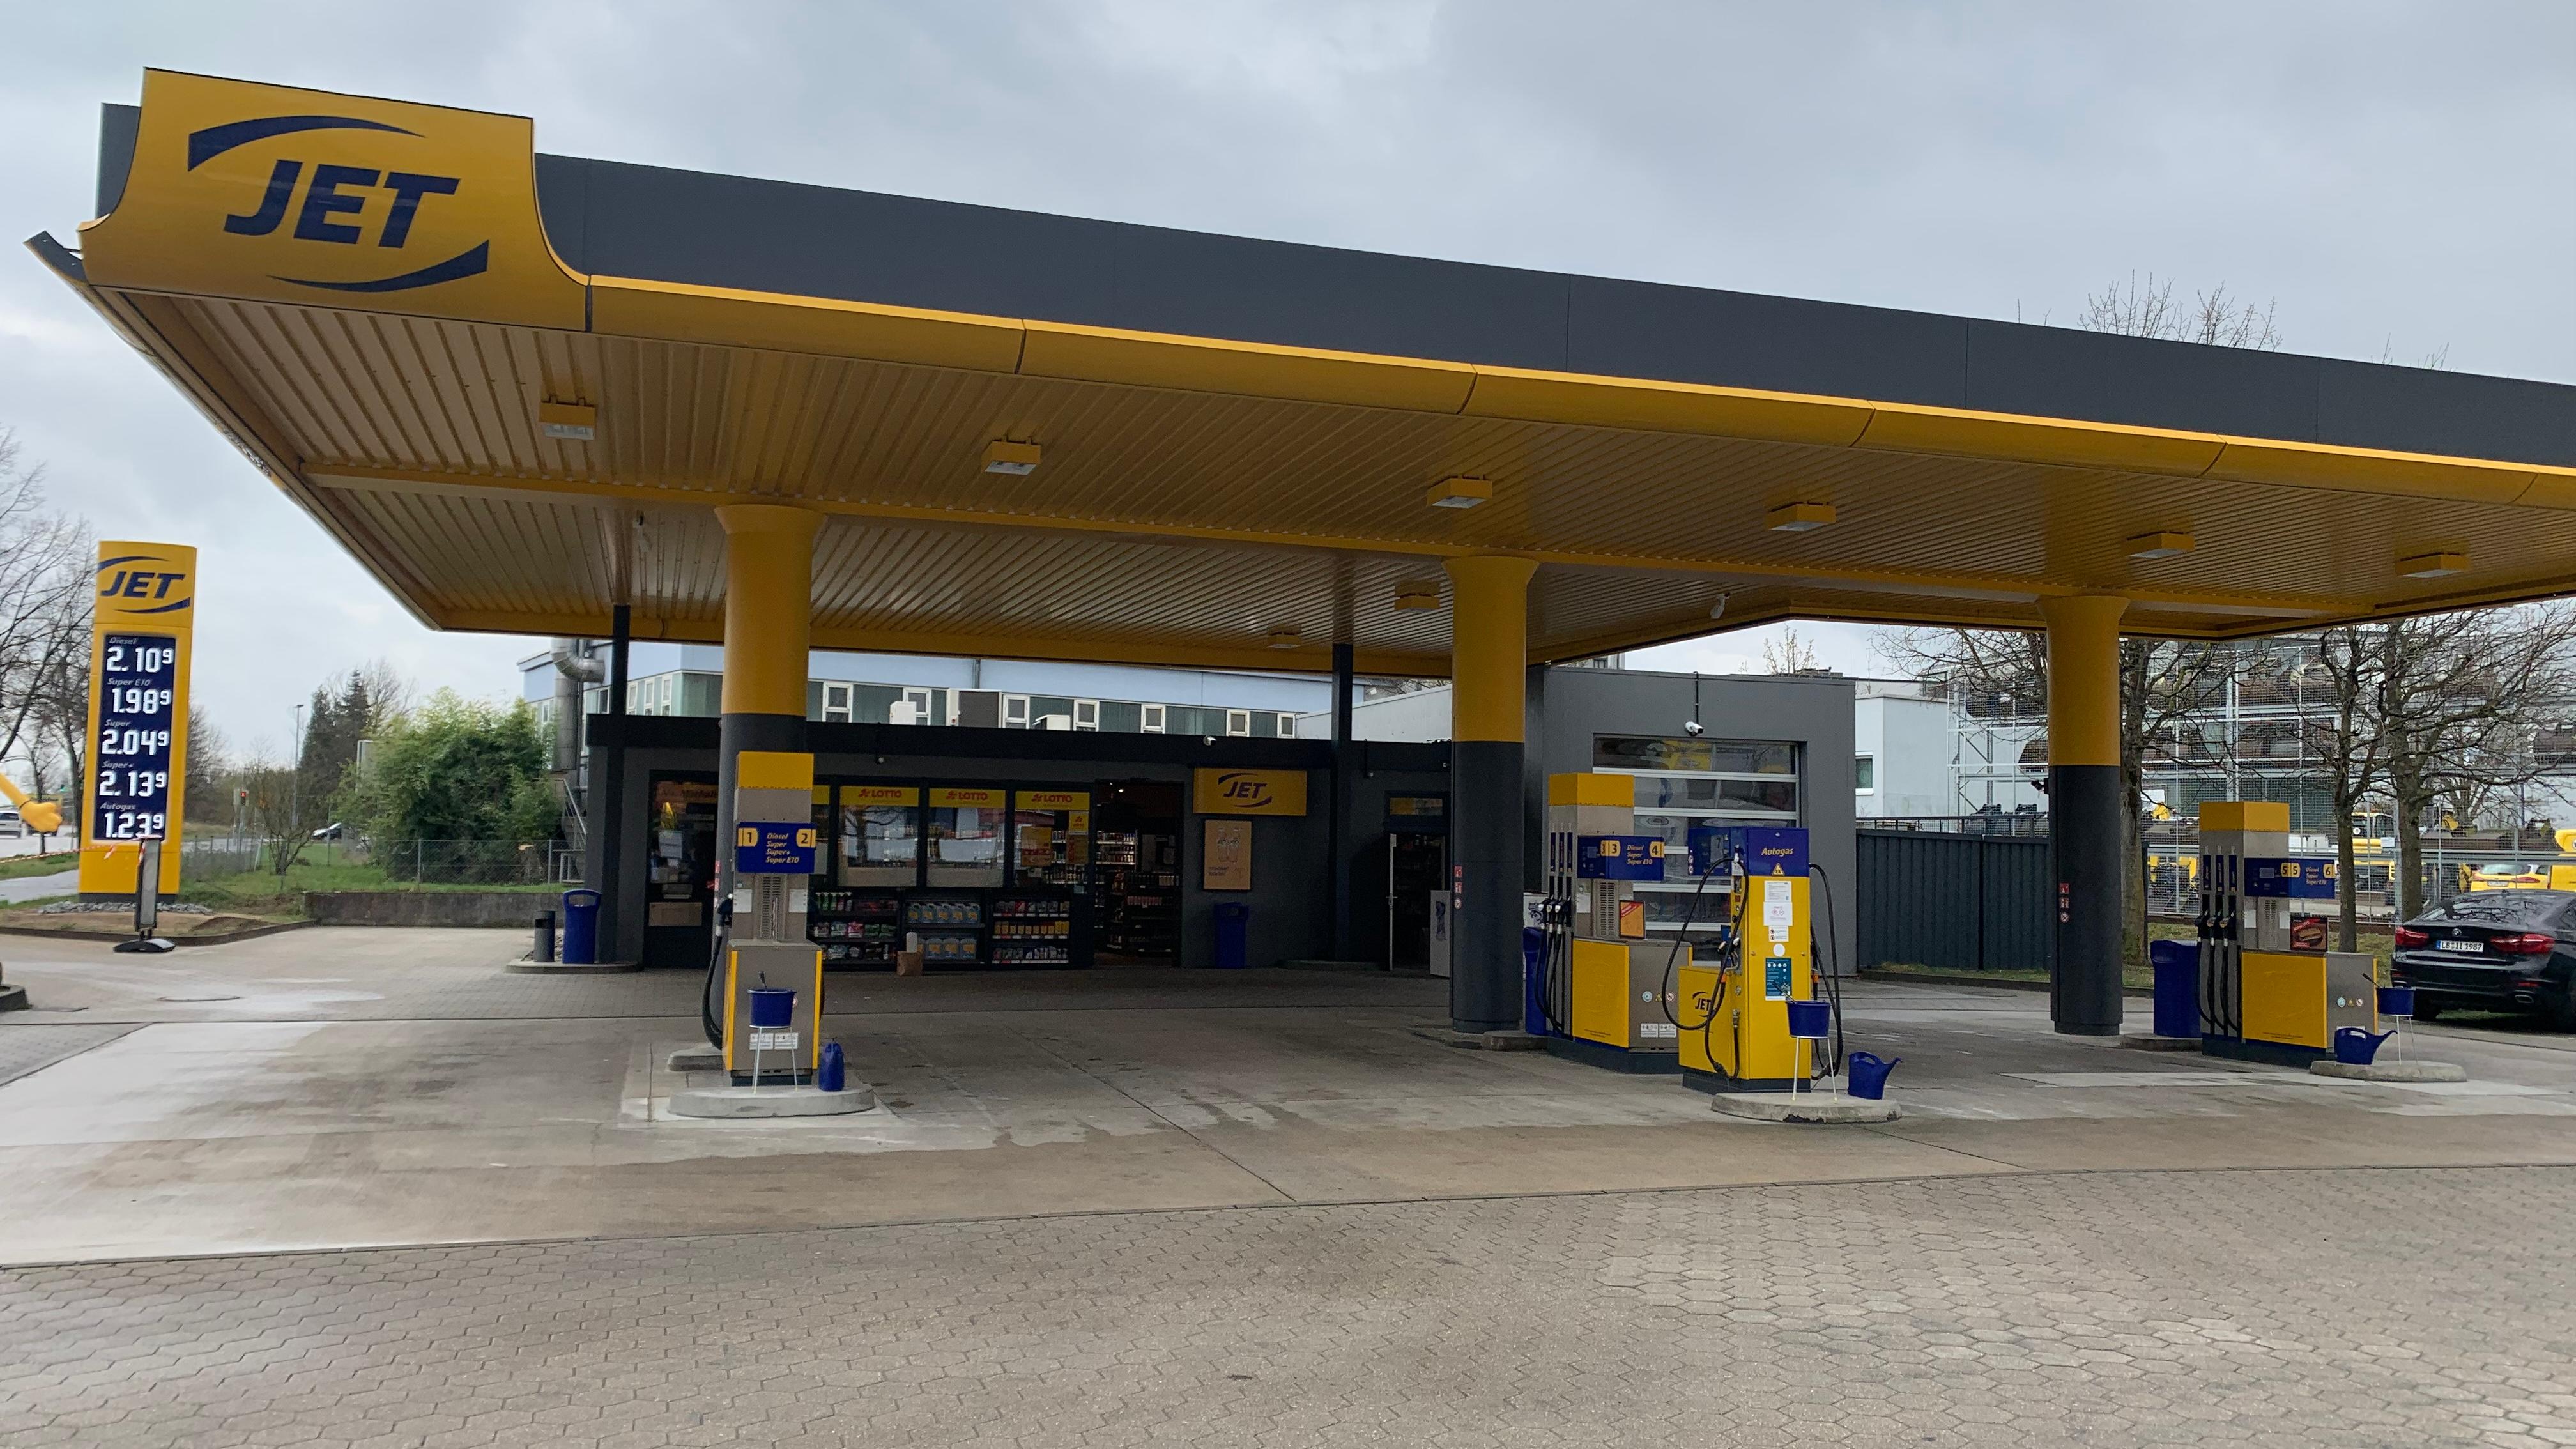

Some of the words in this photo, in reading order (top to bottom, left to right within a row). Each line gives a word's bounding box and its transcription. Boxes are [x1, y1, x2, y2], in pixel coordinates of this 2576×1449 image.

[223, 159, 461, 249] JET
[100, 571, 186, 599] JET
[109, 636, 137, 645] Diesel
[107, 677, 133, 686] Super
[104, 719, 132, 728] Super
[871, 790, 902, 798] LOTTO
[1223, 781, 1268, 799] JET
[958, 791, 988, 800] LOTTO
[1043, 793, 1073, 803] LOTTO
[100, 802, 137, 812] Autogas
[801, 833, 808, 844] 2
[1612, 843, 1618, 854] 3
[1651, 845, 1659, 855] 4
[1761, 847, 1794, 857] Autogas
[765, 856, 786, 864] Super
[2282, 866, 2287, 875] 5
[2292, 866, 2297, 875] 5
[2326, 866, 2331, 875] 6
[2465, 942, 2482, 951] 1987
[1694, 997, 1713, 1011] JET
